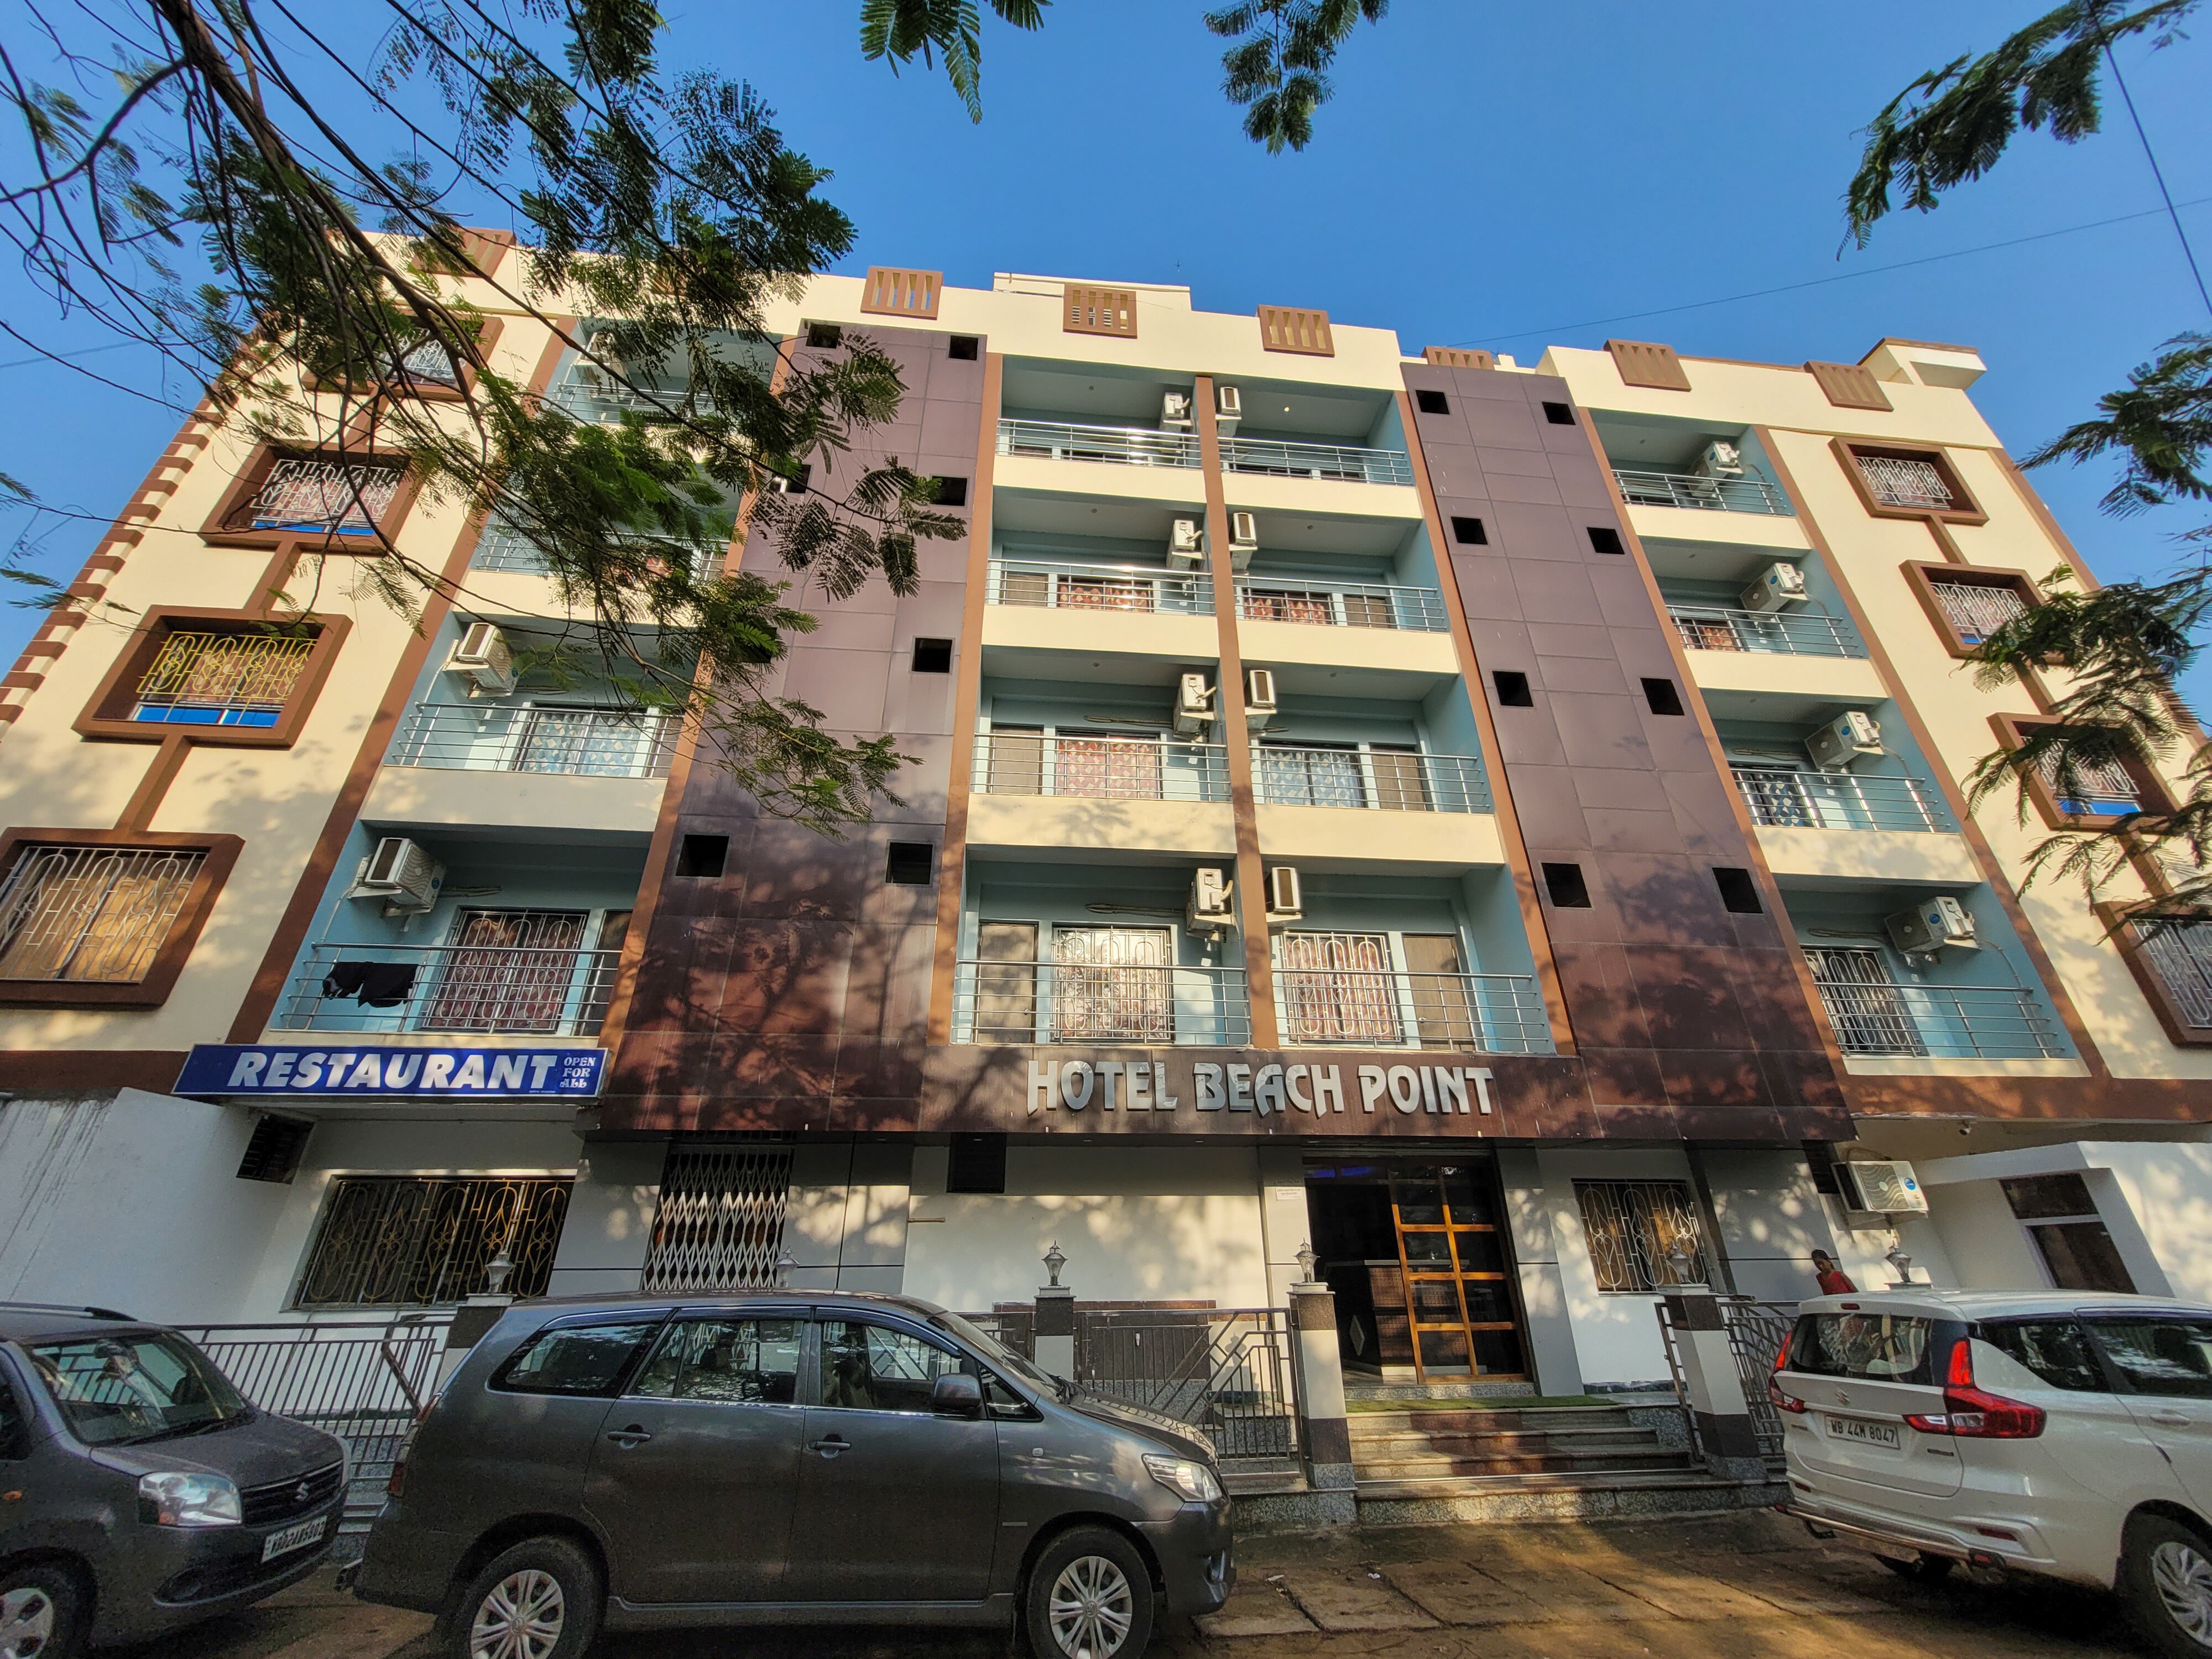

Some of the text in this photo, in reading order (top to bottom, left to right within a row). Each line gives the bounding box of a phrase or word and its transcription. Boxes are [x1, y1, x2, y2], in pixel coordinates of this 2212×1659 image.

[564, 1057, 596, 1067] OPEN
[227, 1052, 558, 1089] RESTAURANT
[562, 1068, 591, 1077] FOR
[559, 1078, 587, 1088] ALL
[1027, 1060, 1494, 1118] HOTEL BEACH POINT
[1831, 1420, 1844, 1434] WB
[1869, 1426, 1895, 1443] 8047
